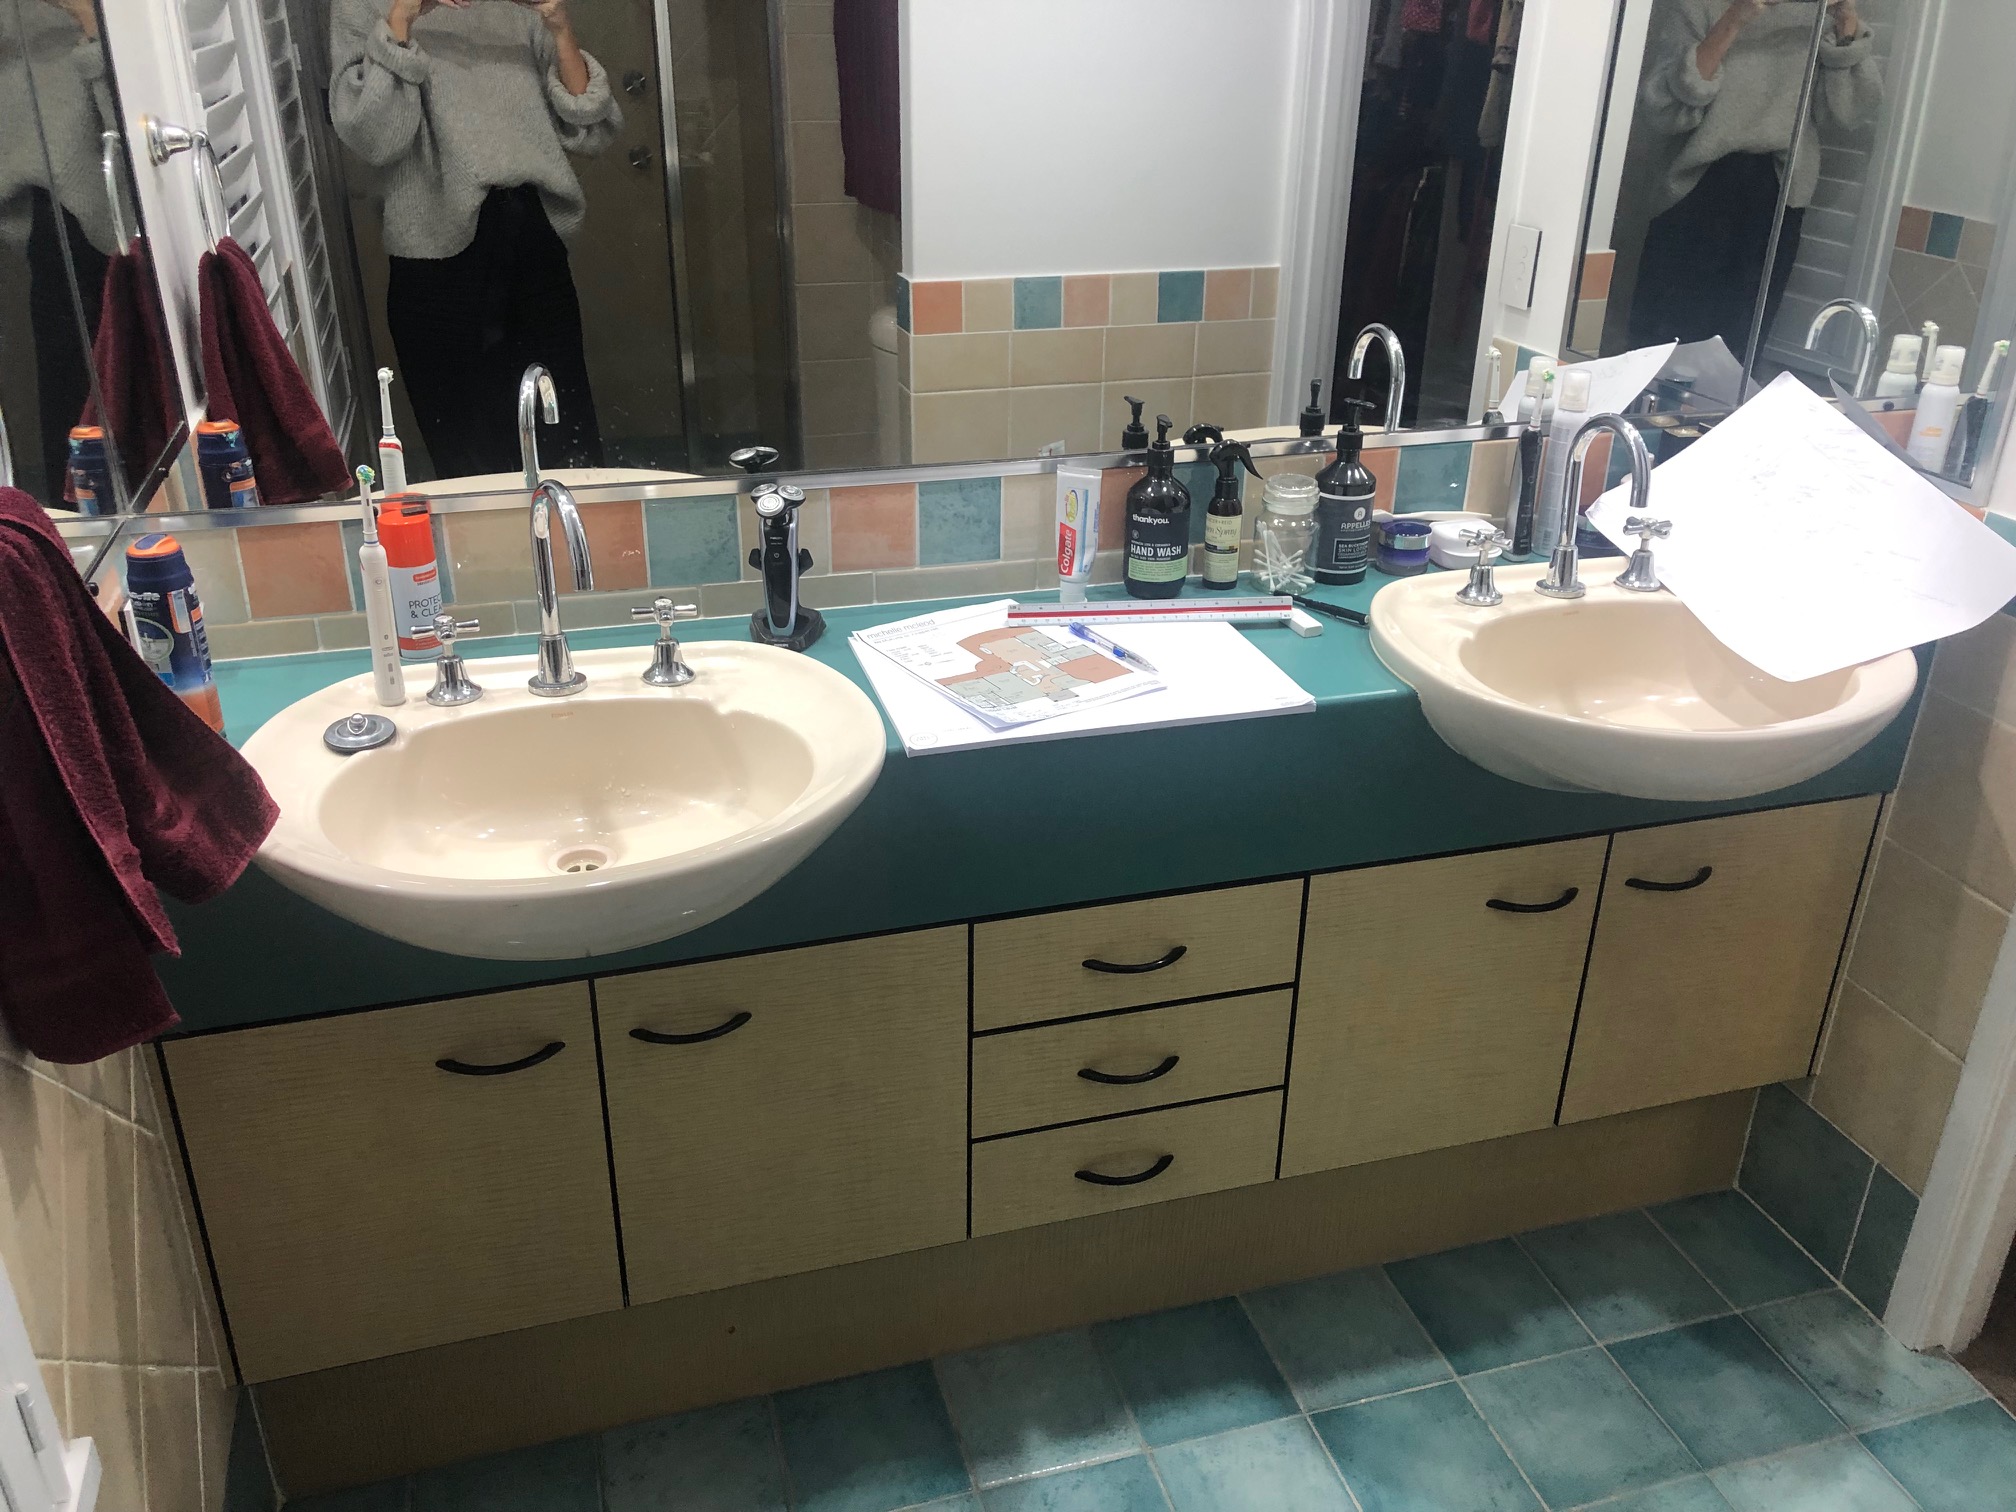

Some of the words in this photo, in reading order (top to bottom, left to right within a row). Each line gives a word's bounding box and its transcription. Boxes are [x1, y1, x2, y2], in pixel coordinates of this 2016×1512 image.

[1132, 514, 1170, 526] thankyou.
[1060, 529, 1073, 574] Colgate
[1130, 544, 1154, 557] HAND
[1157, 545, 1182, 557] WASH
[411, 610, 419, 619] &
